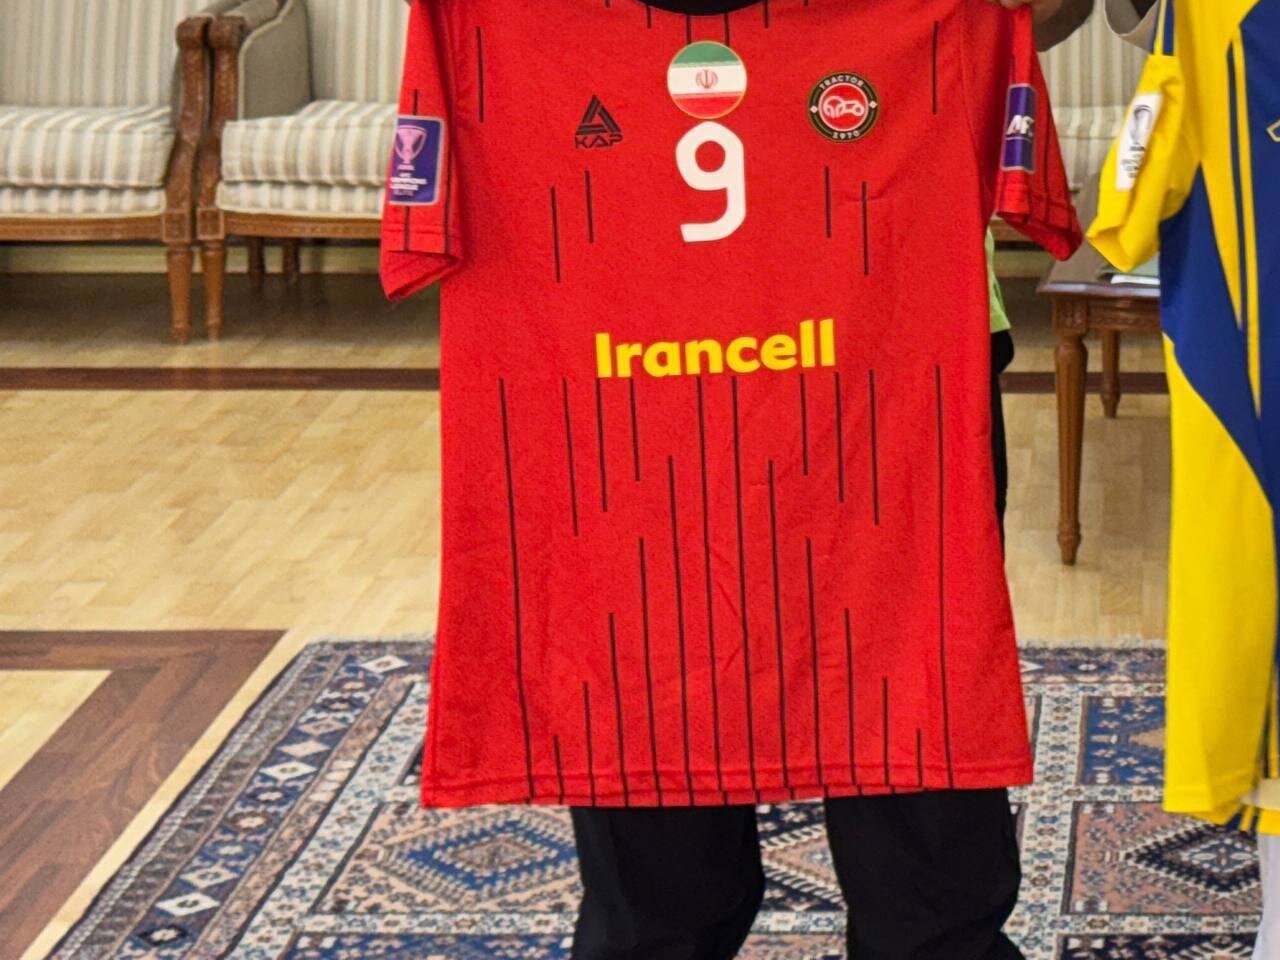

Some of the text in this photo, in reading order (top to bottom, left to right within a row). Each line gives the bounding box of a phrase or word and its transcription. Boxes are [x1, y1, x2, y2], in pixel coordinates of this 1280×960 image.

[819, 75, 864, 90] TRACTOR
[675, 120, 746, 243] 9
[595, 318, 836, 379] Irancell
